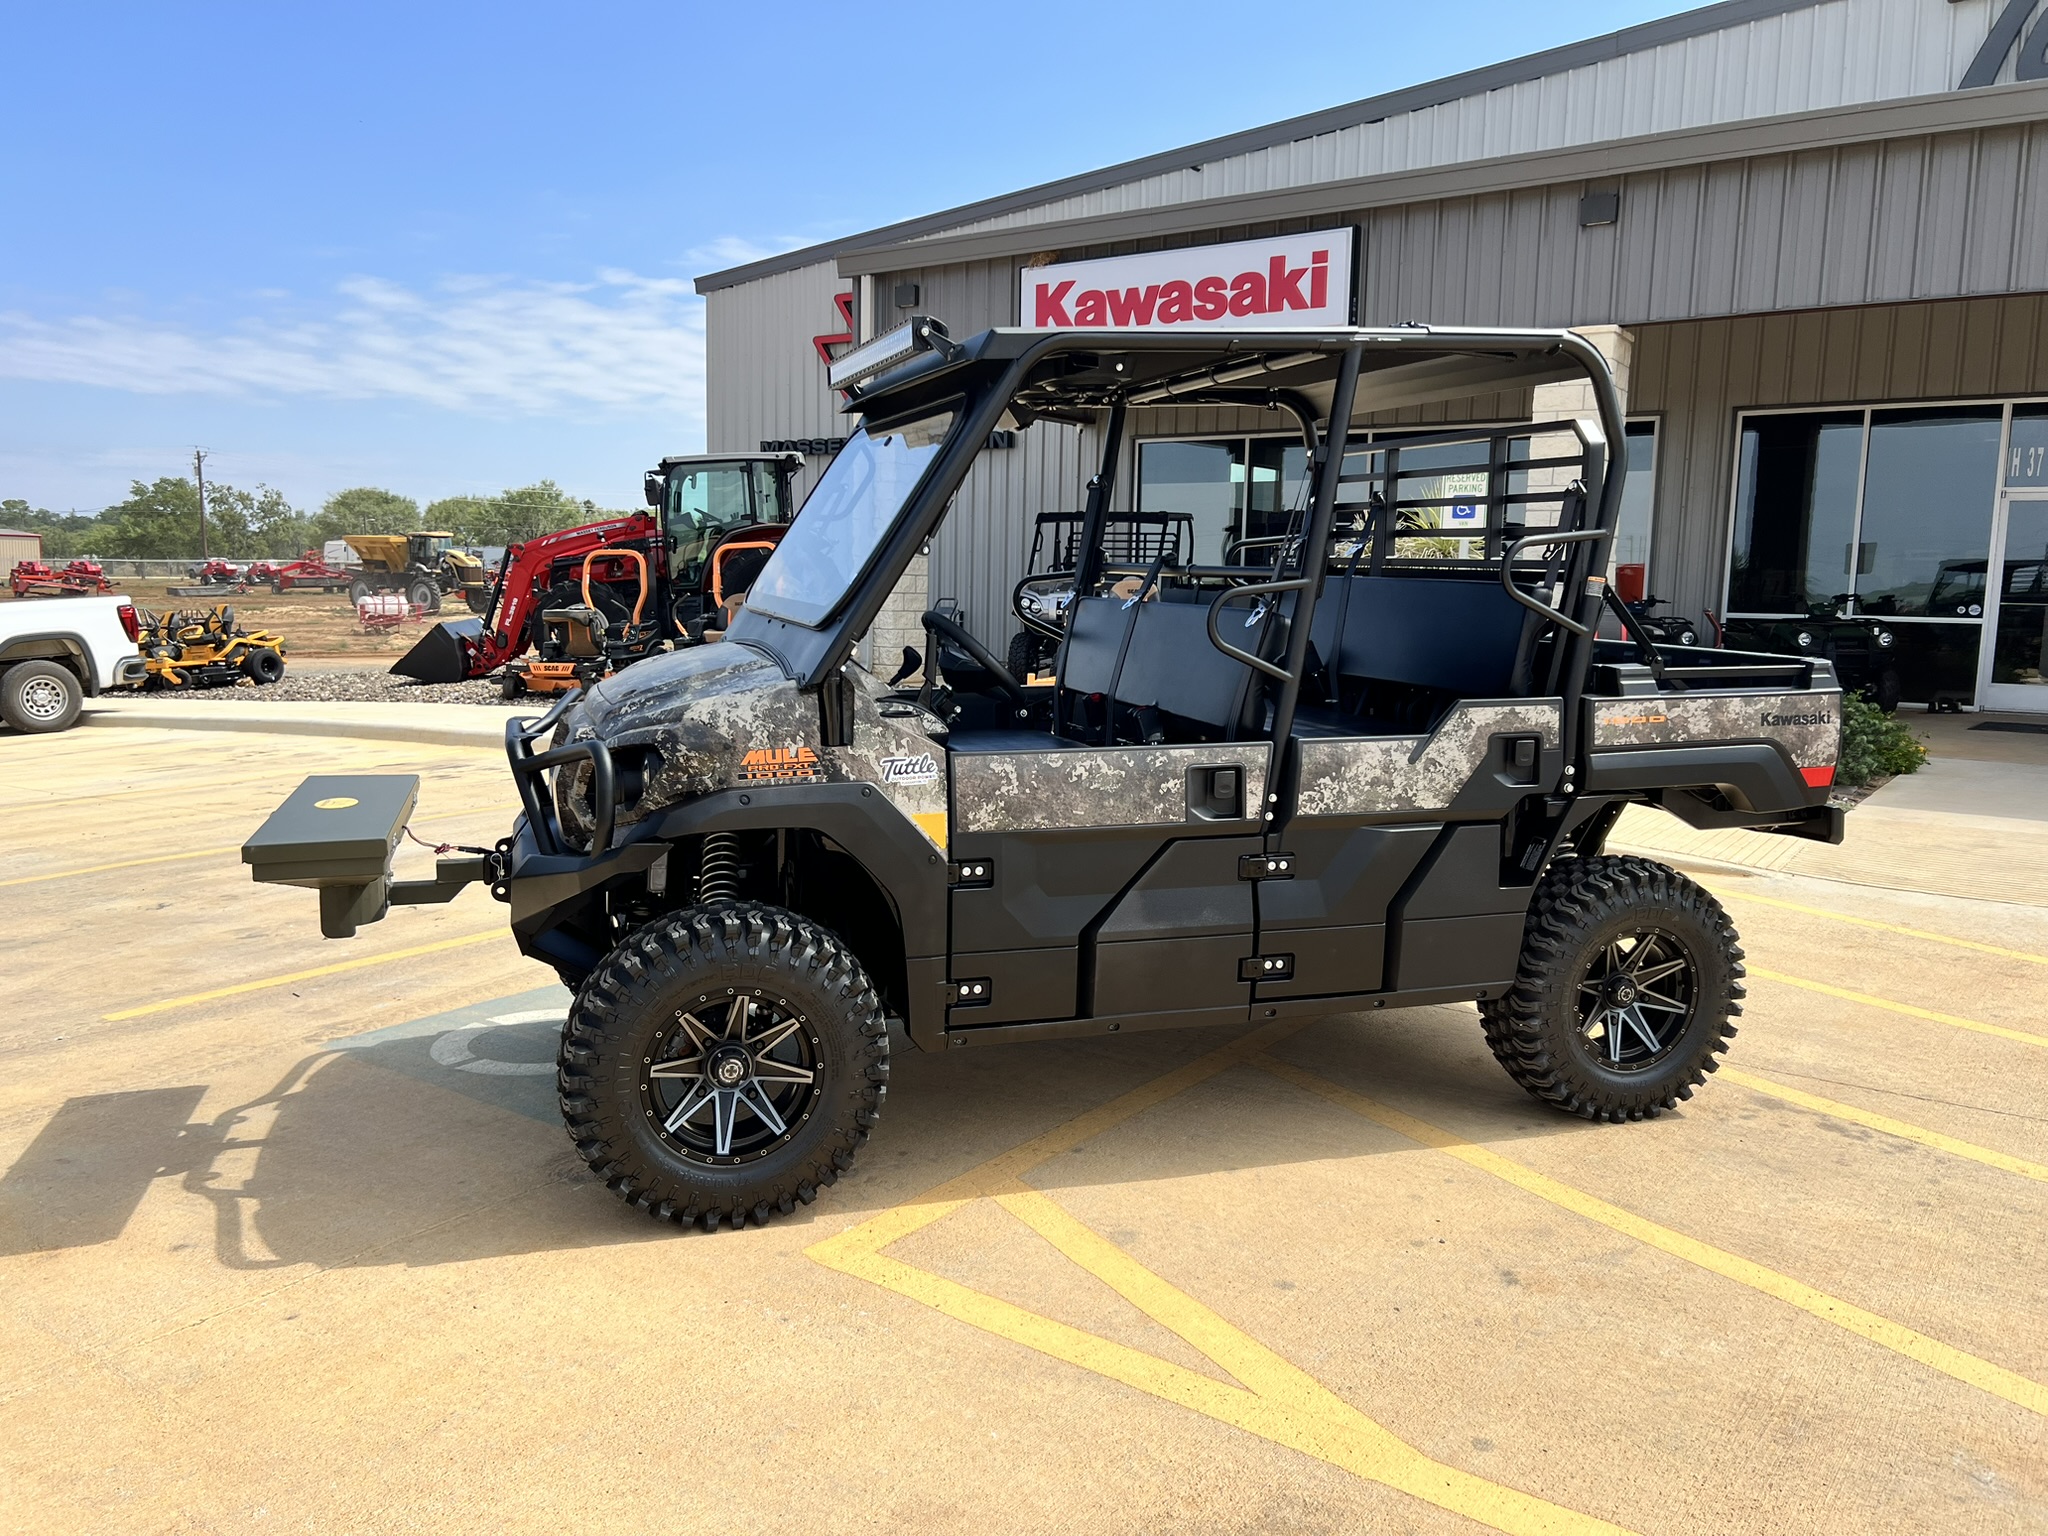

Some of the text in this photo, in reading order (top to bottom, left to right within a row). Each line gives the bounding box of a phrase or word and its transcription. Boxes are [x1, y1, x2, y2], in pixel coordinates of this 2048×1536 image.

[1036, 250, 1329, 327] Kawasaki
[2027, 447, 2045, 477] 37
[1446, 472, 1486, 483] RESERVED
[1448, 484, 1483, 493] PARKING
[1760, 710, 1831, 727] Kawasaki
[740, 747, 819, 766] MULE
[747, 770, 814, 779] 1000
[882, 754, 937, 782] Tuttle
